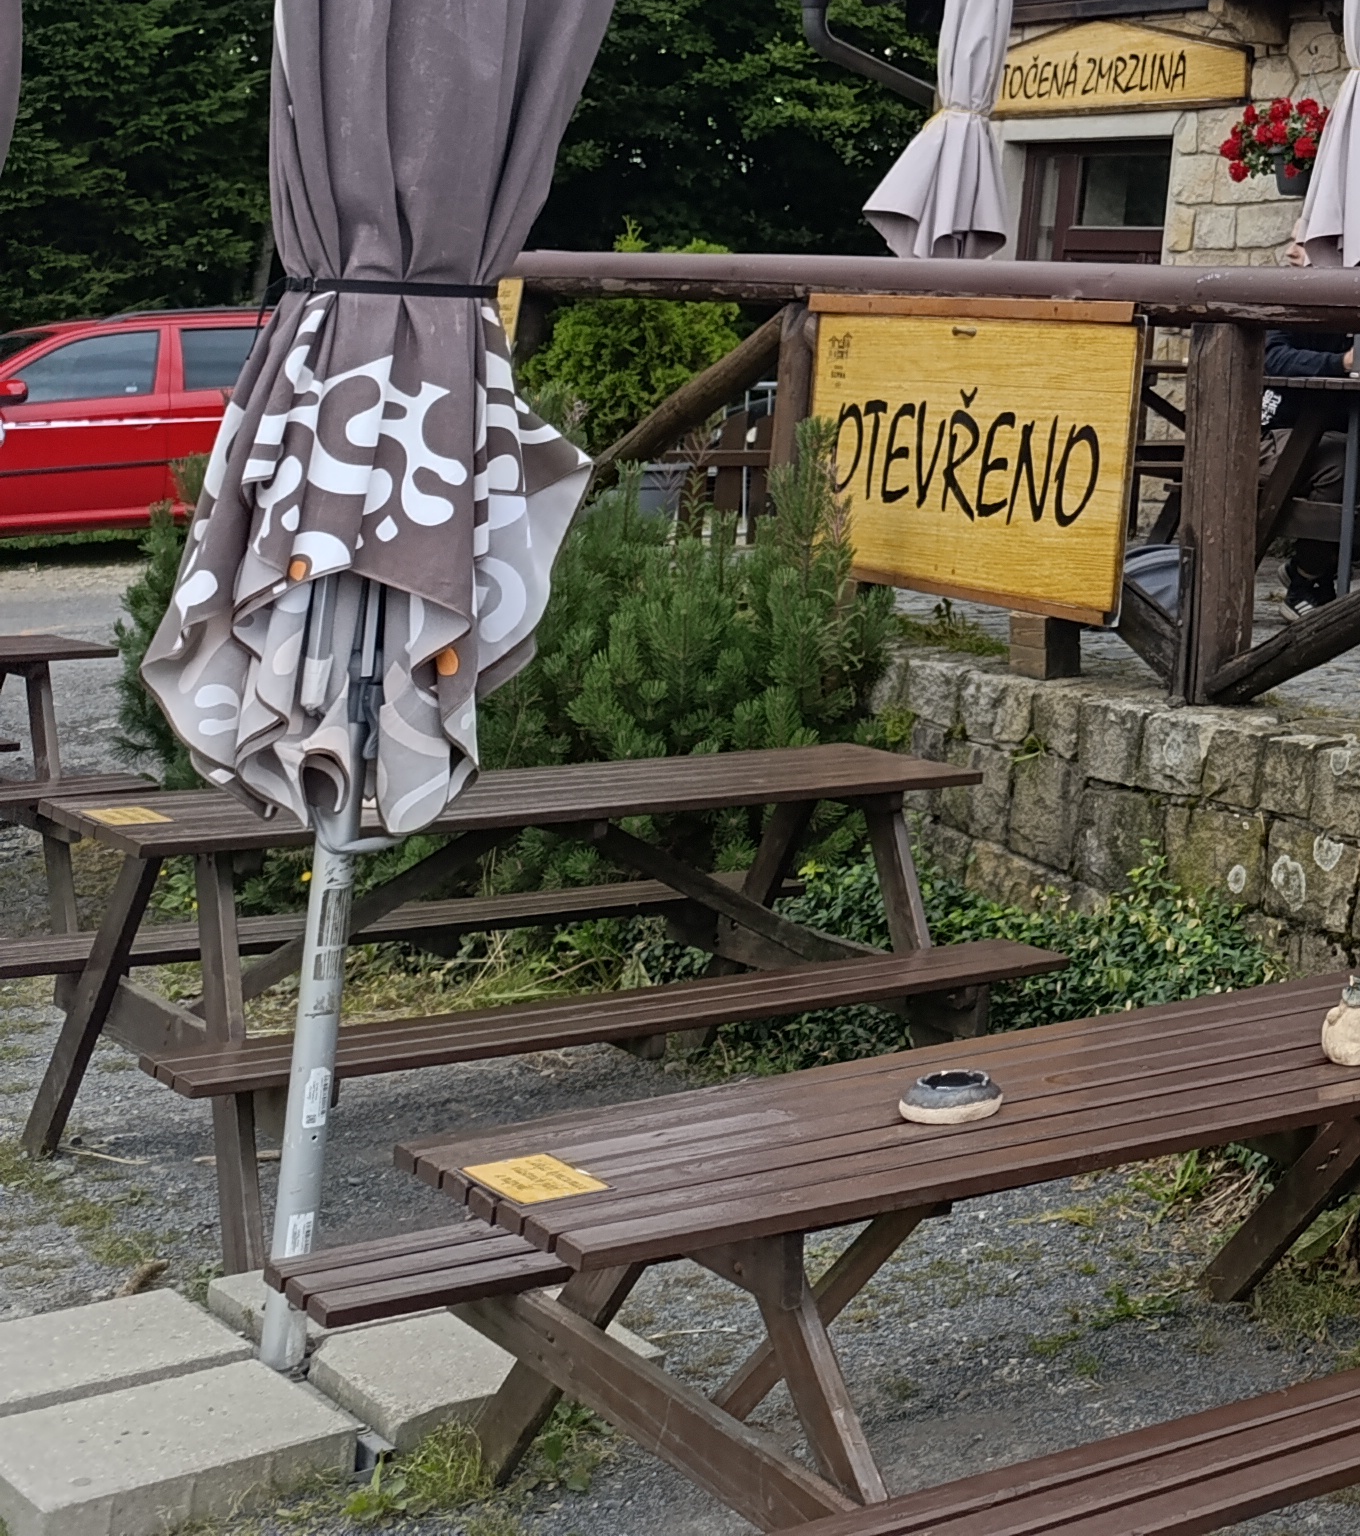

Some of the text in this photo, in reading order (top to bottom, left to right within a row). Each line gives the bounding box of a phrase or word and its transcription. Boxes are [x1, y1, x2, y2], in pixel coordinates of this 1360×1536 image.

[1002, 50, 1187, 99] TOČENÁ ZMRZLINA
[833, 387, 1100, 527] OTEVŘENO
